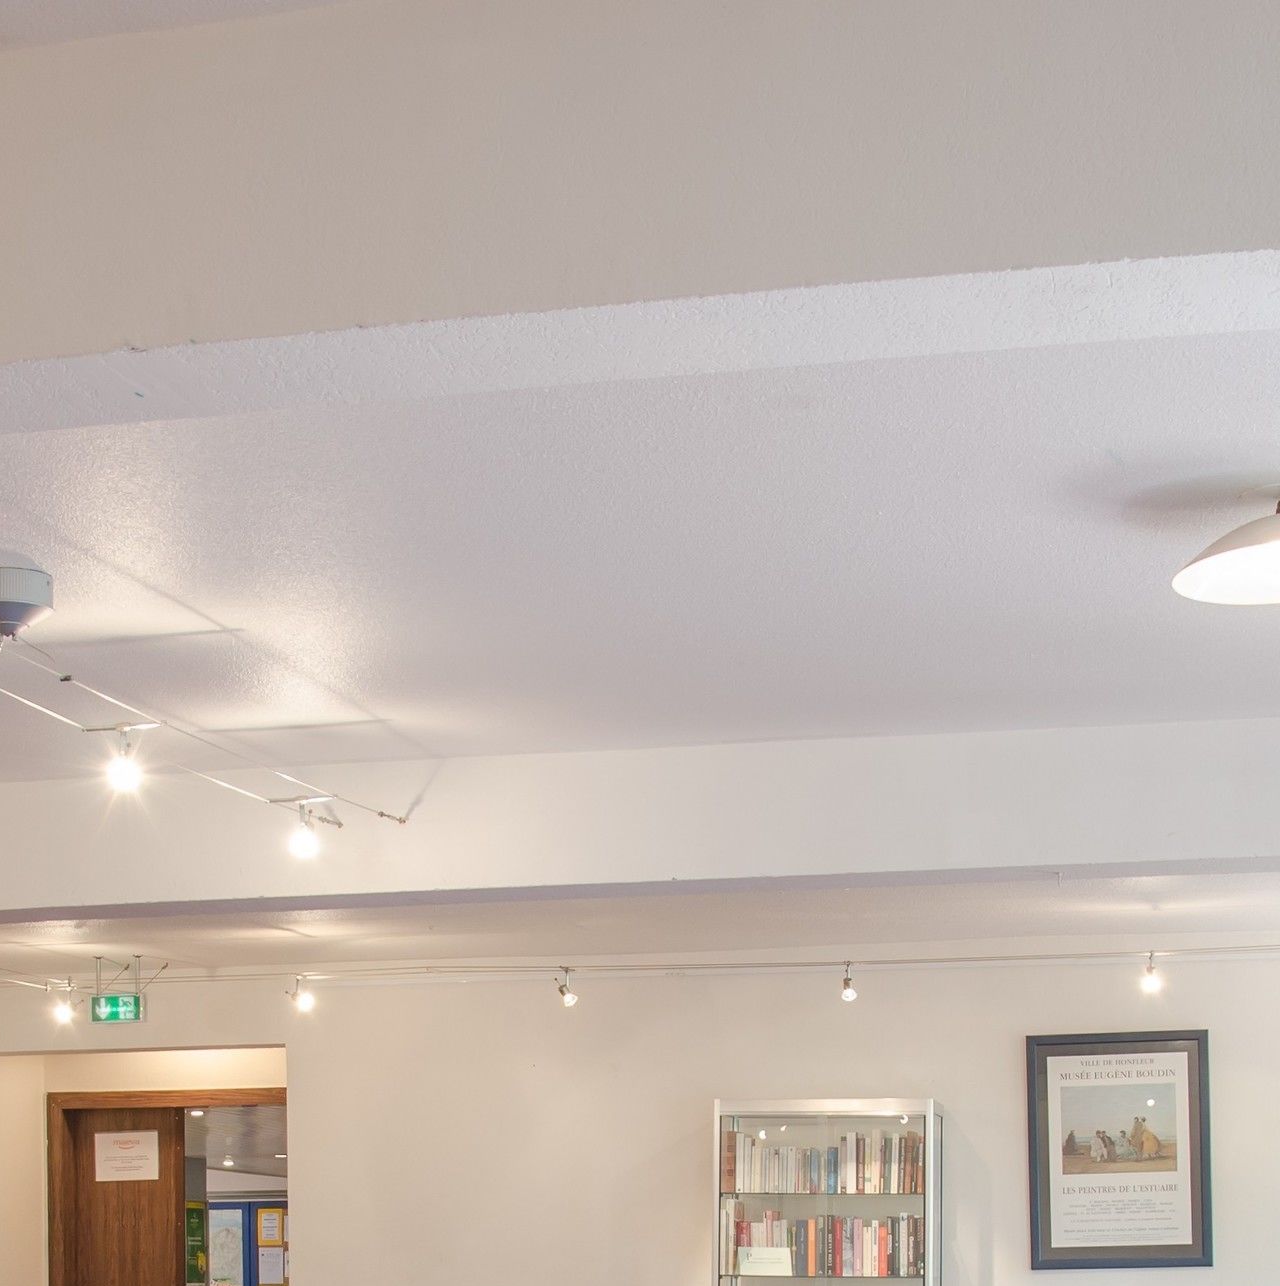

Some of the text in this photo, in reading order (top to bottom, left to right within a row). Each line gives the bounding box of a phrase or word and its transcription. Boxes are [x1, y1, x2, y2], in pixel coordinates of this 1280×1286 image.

[1115, 1058, 1154, 1066] HONFLEUR
[1060, 1070, 1090, 1080] MUSÉE
[1136, 1069, 1176, 1077] BOUDIN
[1062, 1183, 1178, 1194] LES PEINTRES DE L'ESTUAIRE
